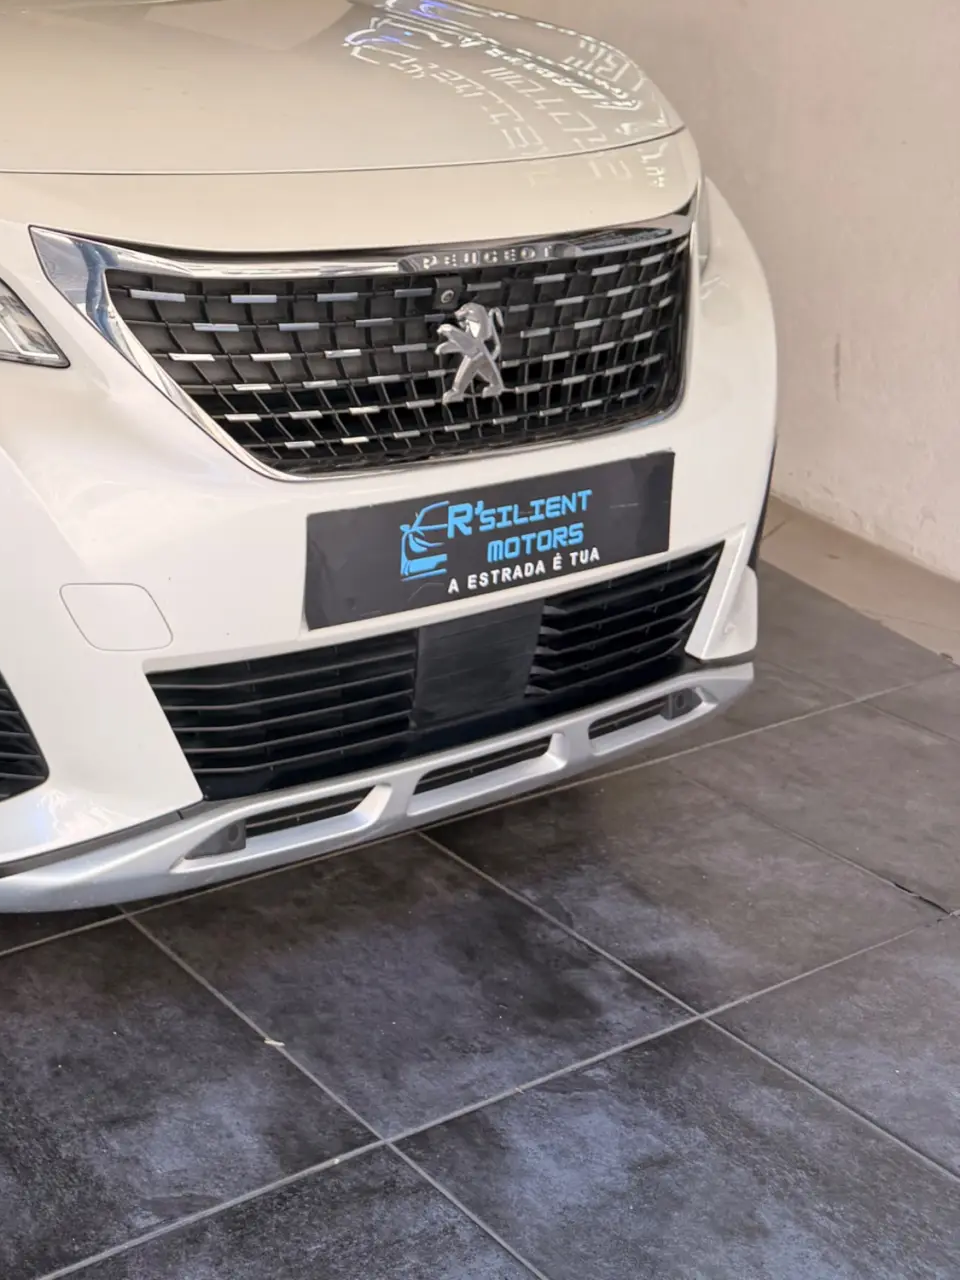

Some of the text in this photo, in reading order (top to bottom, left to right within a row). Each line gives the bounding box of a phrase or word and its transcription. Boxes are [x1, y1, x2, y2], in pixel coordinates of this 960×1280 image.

[422, 244, 554, 270] PEUGEOT
[487, 522, 584, 563] MOTORS
[447, 546, 601, 595] A ESTRADA É TUA
